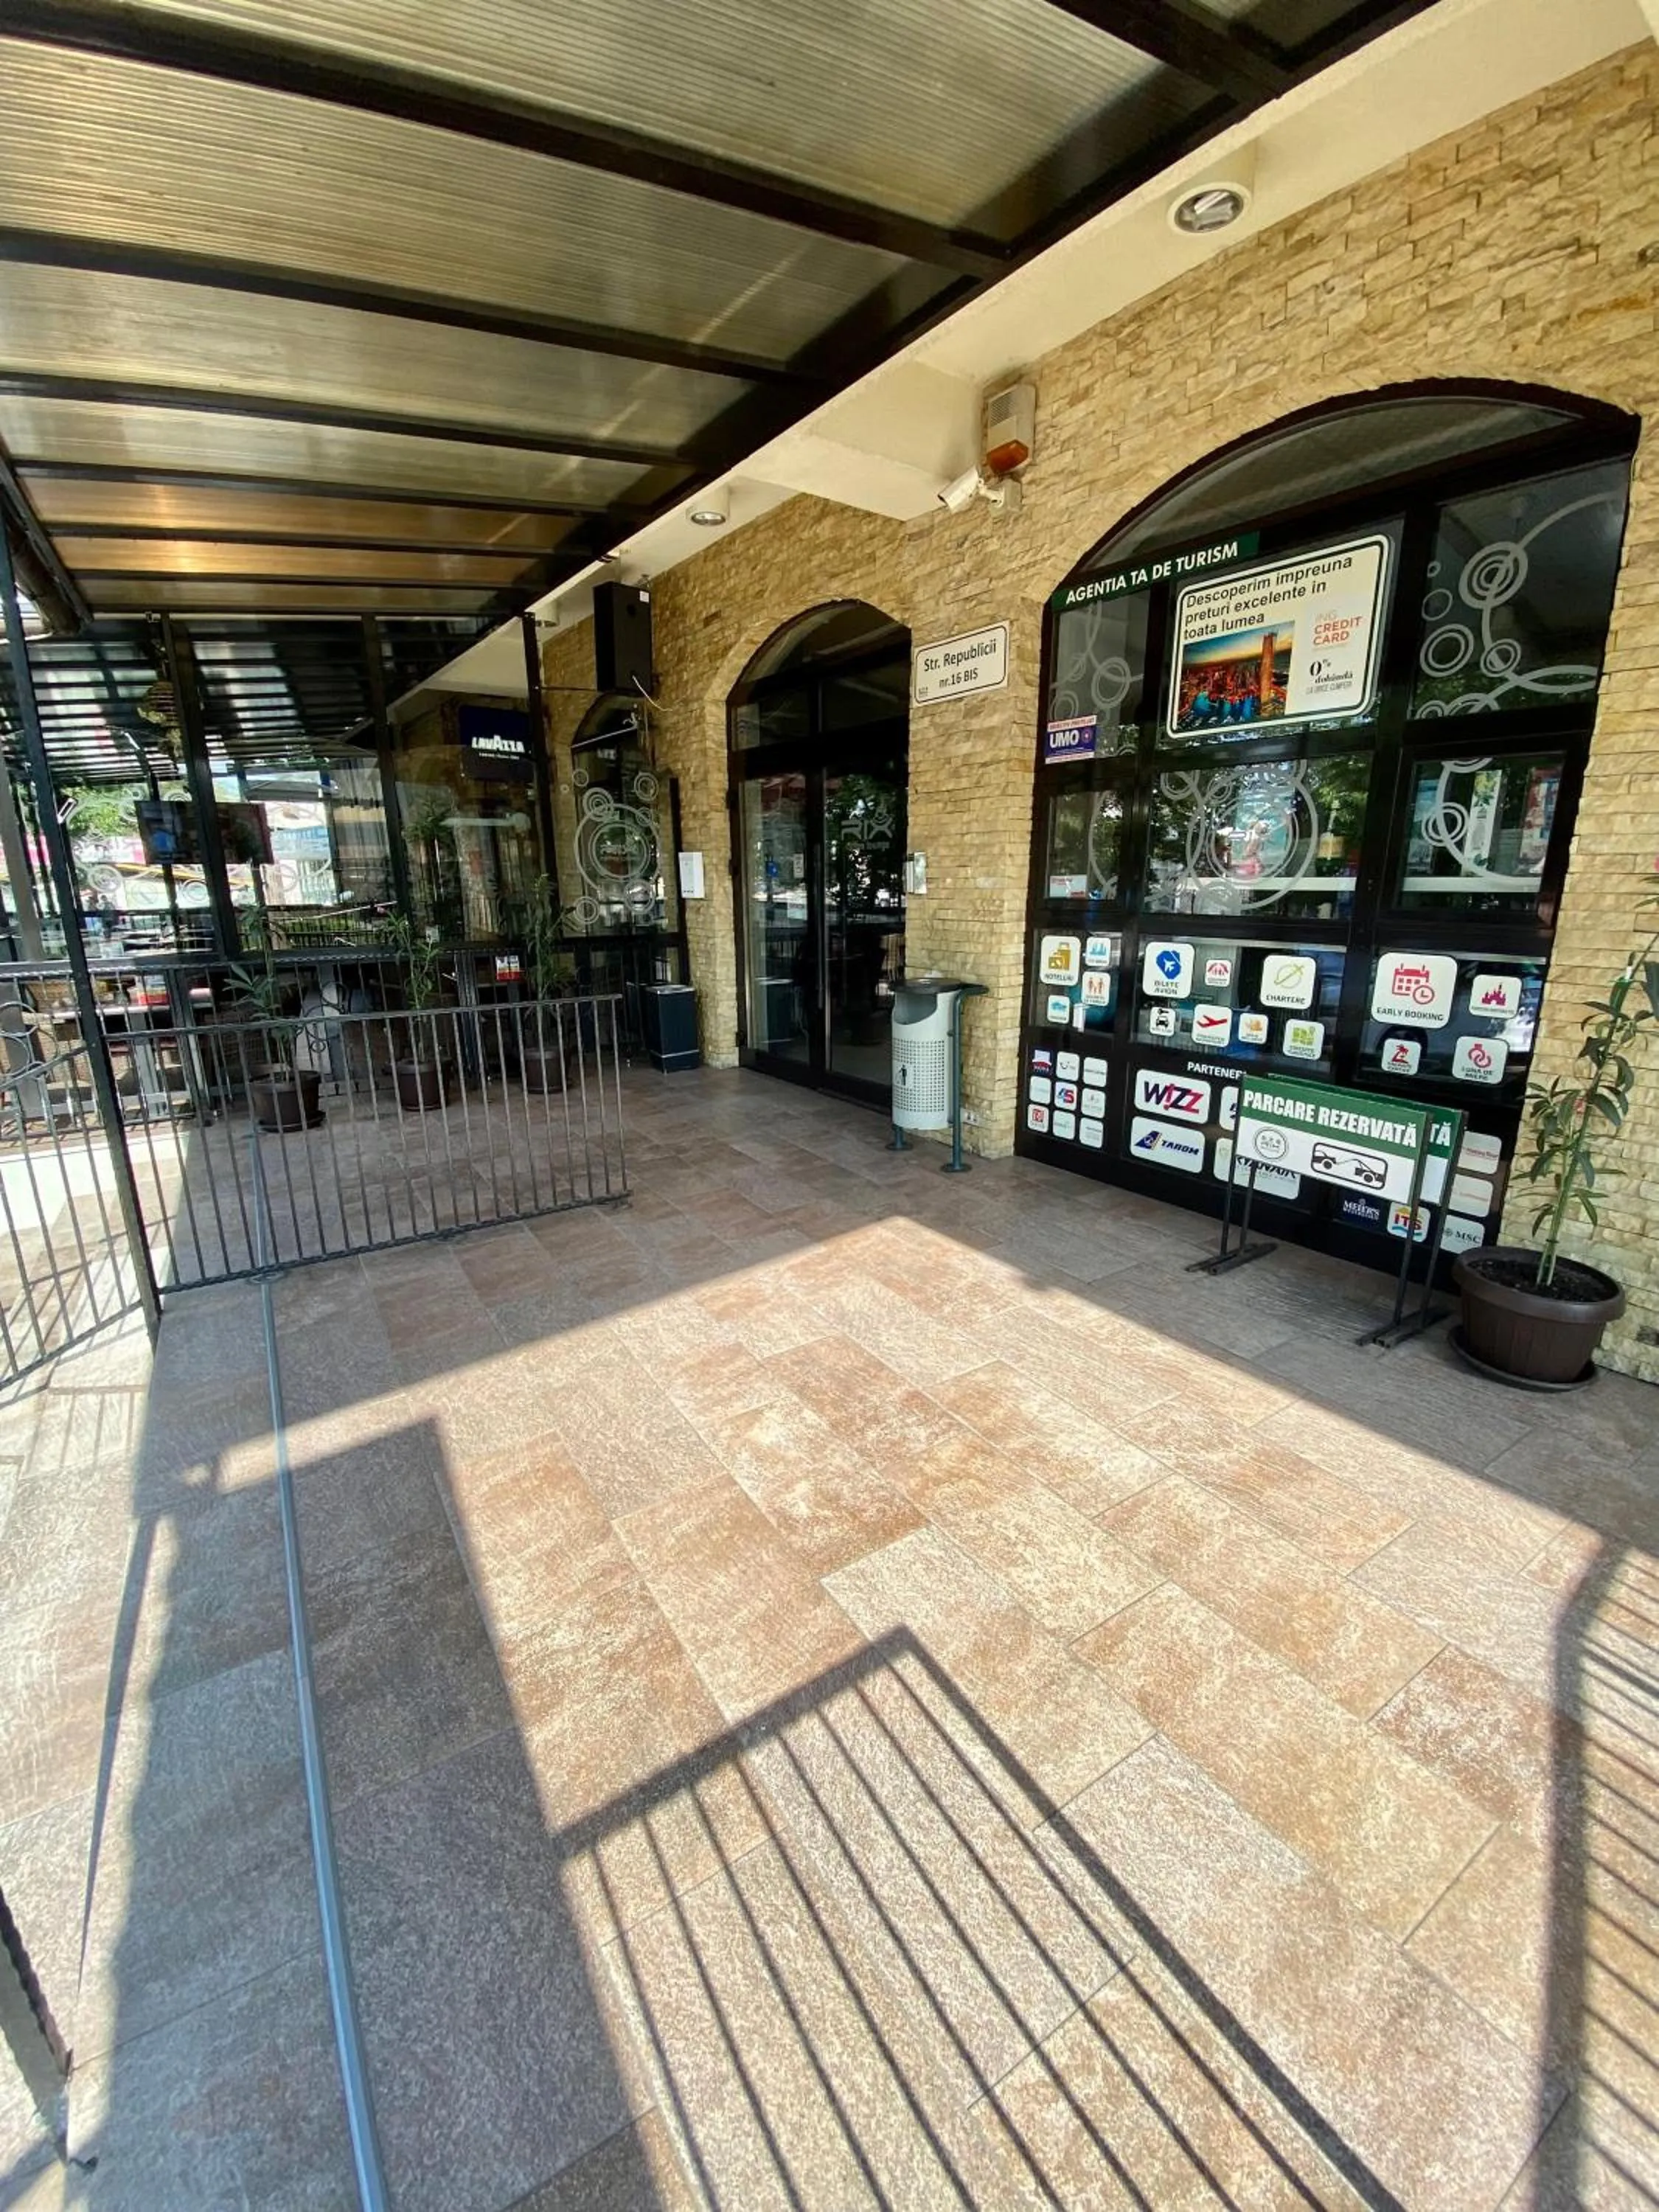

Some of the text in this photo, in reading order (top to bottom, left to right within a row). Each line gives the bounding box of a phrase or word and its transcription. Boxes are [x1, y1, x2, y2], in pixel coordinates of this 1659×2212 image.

[1066, 541, 1239, 605] AGENTIA TA DE TURISM
[1186, 557, 1353, 608] Descoperim impreuna
[1185, 581, 1326, 627] preturi excelente in
[1184, 613, 1265, 641] toata lumea
[1315, 616, 1363, 634] CREDIT
[1313, 631, 1349, 645] CARD
[924, 639, 996, 672] Str. Republicii
[964, 667, 978, 682] BIS
[472, 734, 525, 753] LAVAZZA
[1377, 1006, 1444, 1021] EARLY BOOKING
[1243, 1089, 1315, 1124] PARCARE
[1318, 1107, 1416, 1148] REZERVATĂ
[1161, 1139, 1200, 1155] TAROM
[1455, 1231, 1481, 1244] MSC
